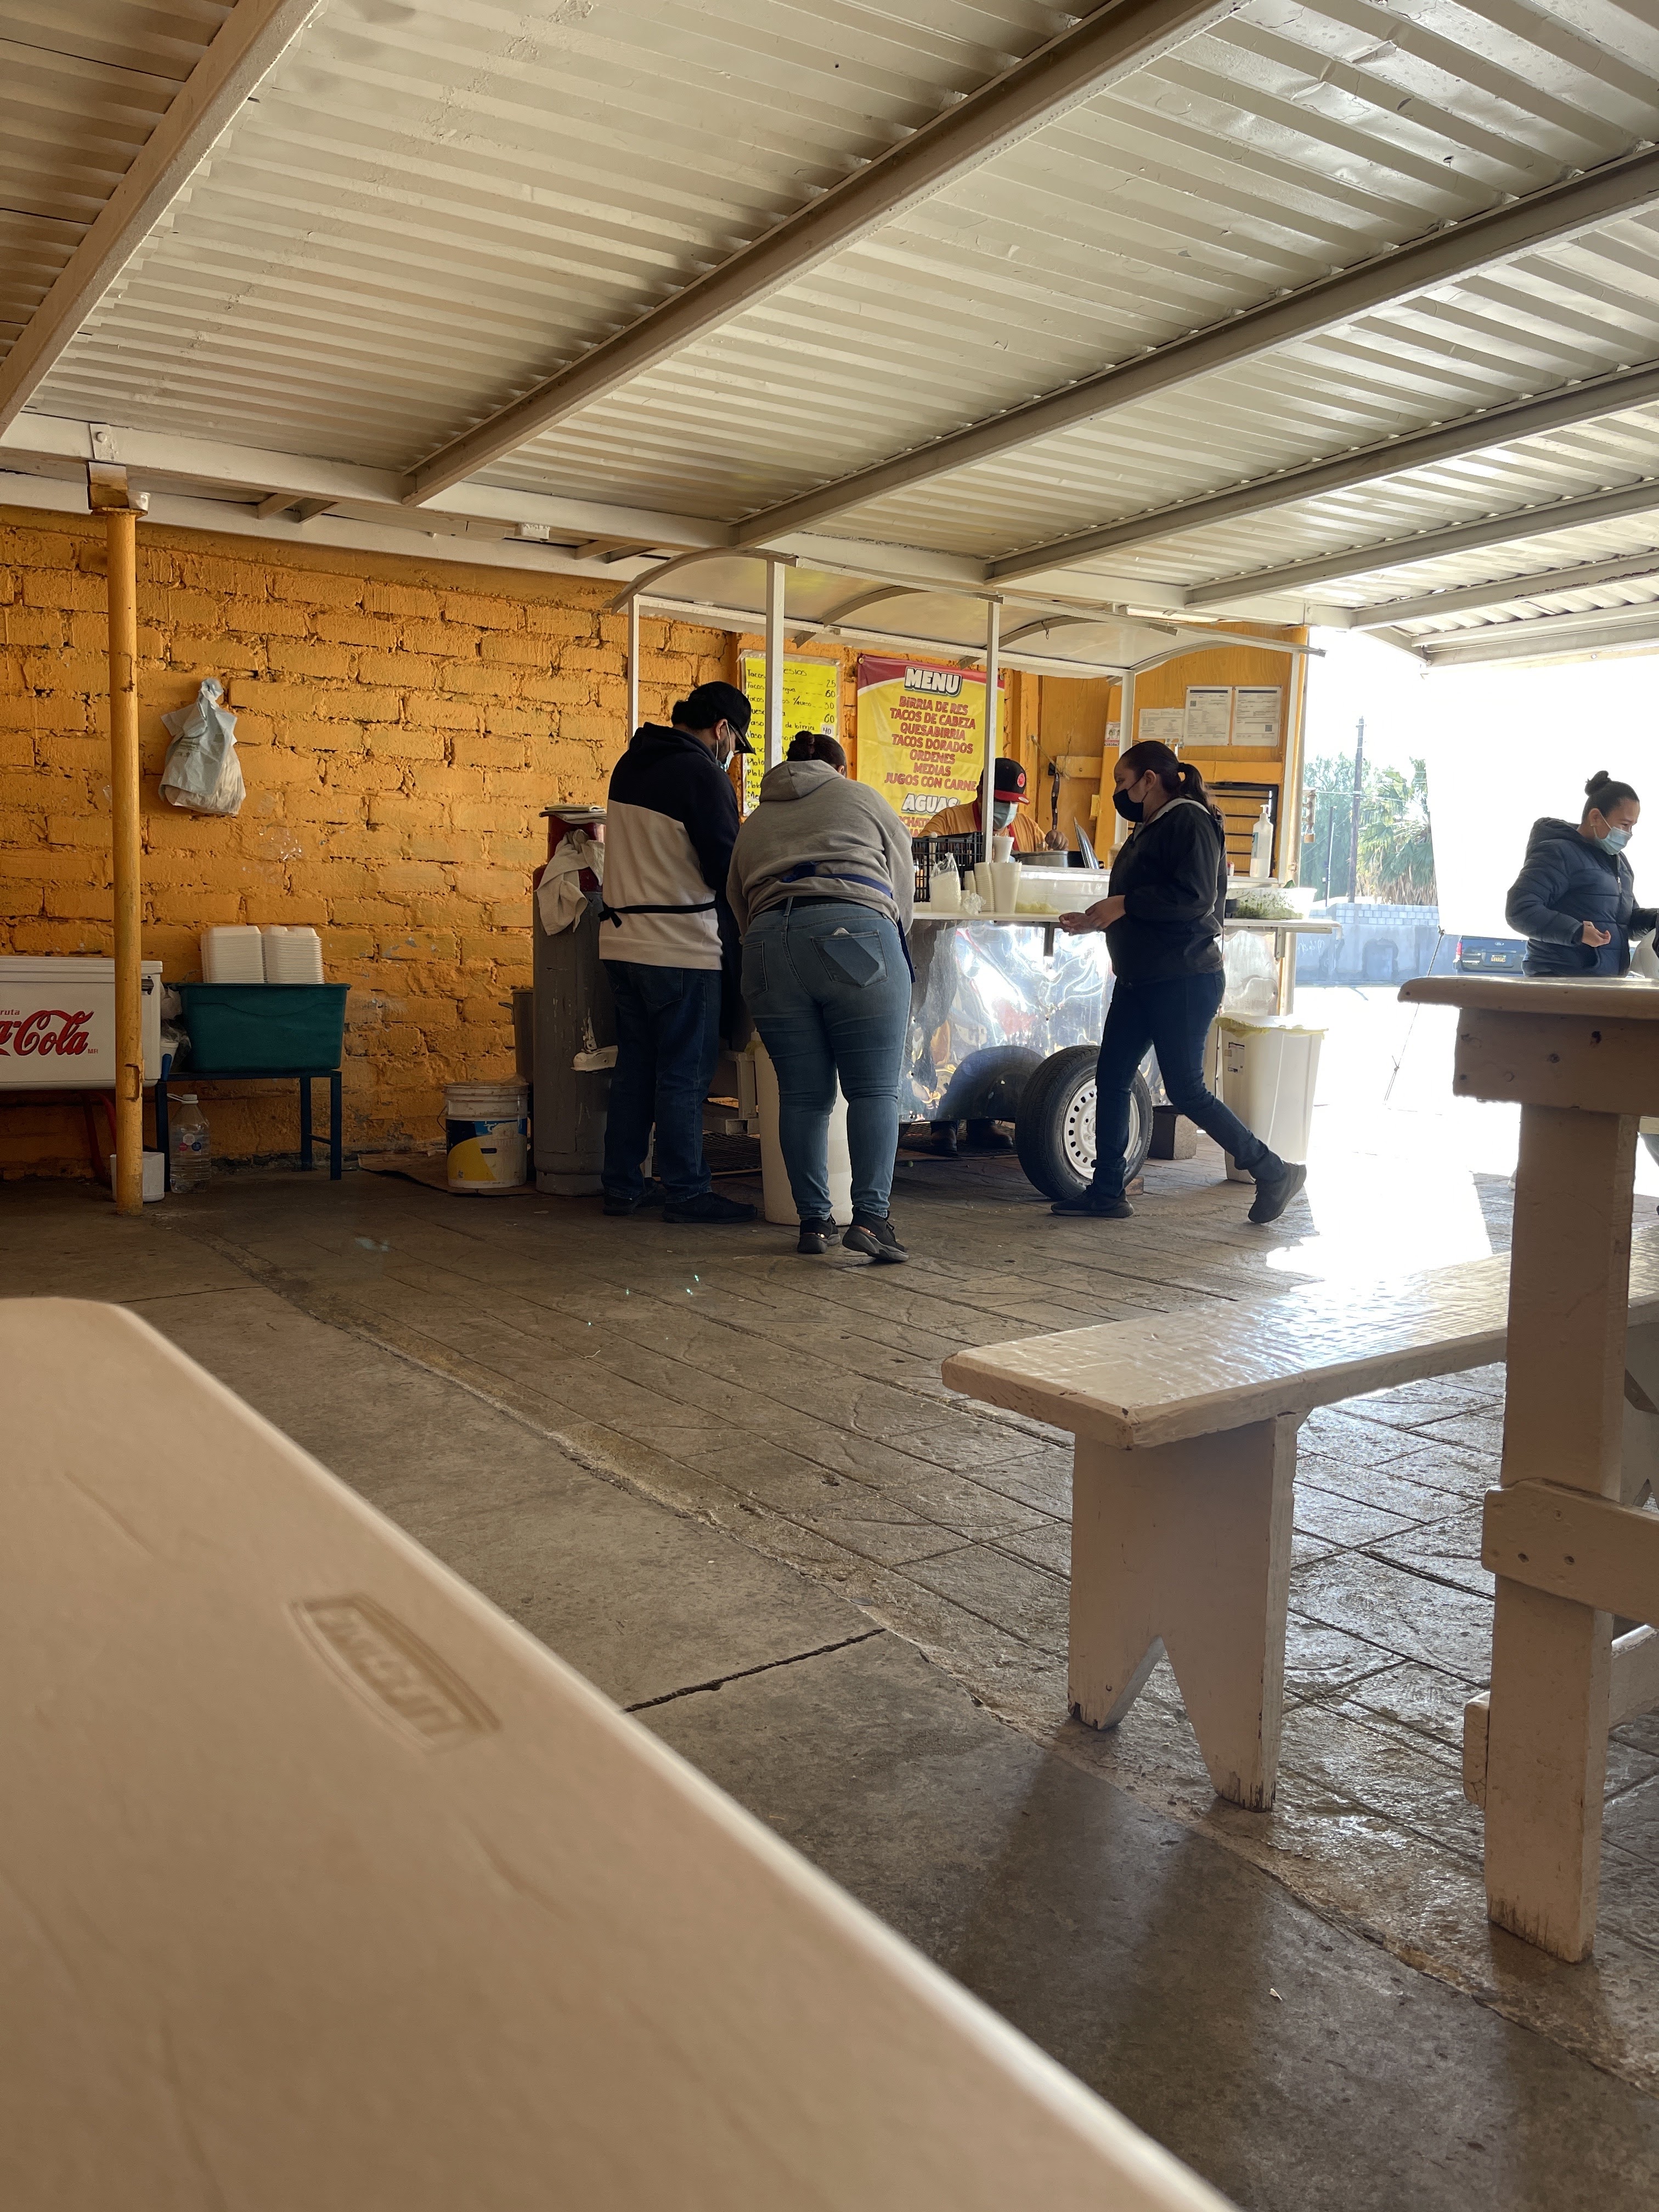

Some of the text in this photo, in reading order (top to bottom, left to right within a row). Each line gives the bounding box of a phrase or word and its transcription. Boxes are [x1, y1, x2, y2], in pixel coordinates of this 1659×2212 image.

[747, 669, 836, 688] Tacos 25
[905, 667, 961, 696] MENU
[747, 694, 764, 703] Tacos
[899, 696, 968, 715] BIRRIA DE RES
[824, 713, 834, 723] 60
[890, 707, 975, 729] TACOS DE CABEZA
[900, 723, 966, 740] QUESABIRRIA
[892, 734, 973, 754] TACOS DORADOS
[910, 749, 955, 764] ORDENES
[913, 763, 951, 776] MEDIAS
[884, 772, 977, 791] JUGOS CON CARNE
[901, 793, 960, 814] AGUAS
